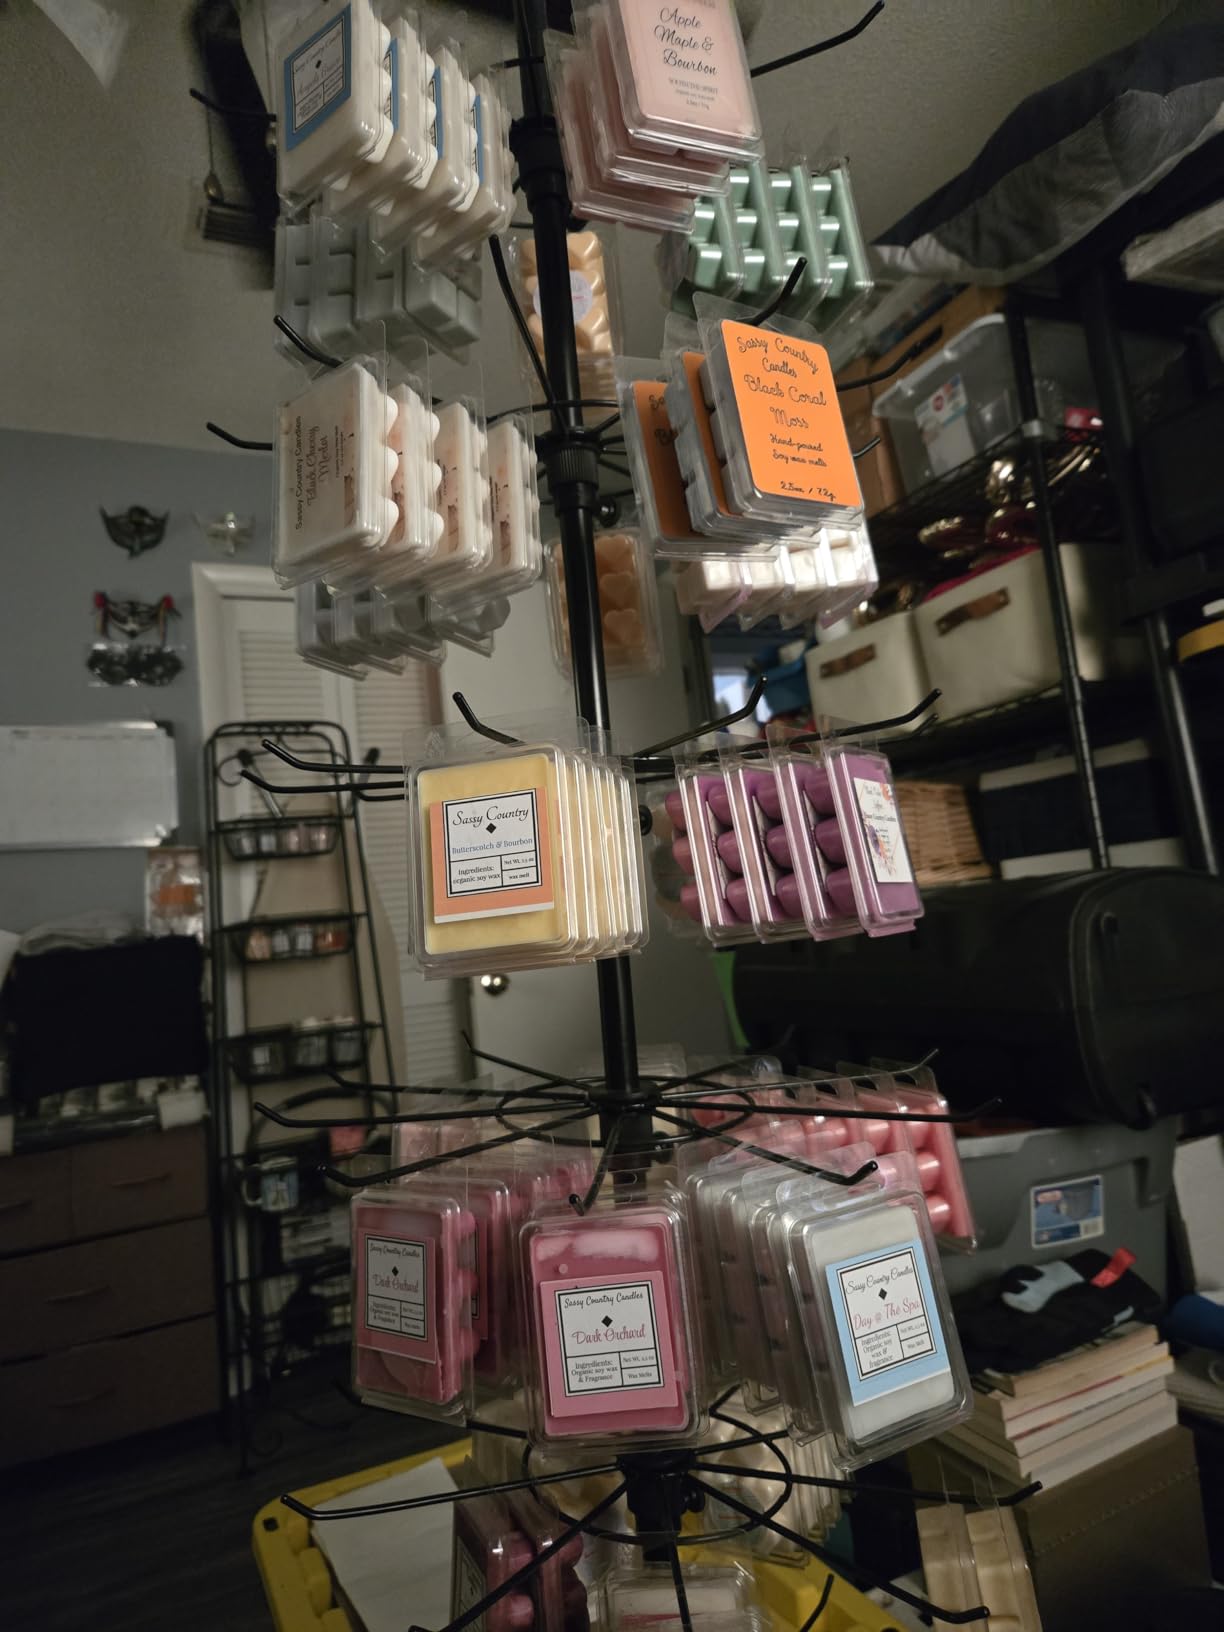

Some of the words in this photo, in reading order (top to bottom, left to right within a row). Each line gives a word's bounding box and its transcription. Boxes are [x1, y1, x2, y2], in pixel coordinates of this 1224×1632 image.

[660, 7, 701, 28] Apple
[654, 24, 699, 49] Maple
[702, 36, 714, 53] &
[663, 48, 717, 76] Bourbon
[737, 336, 768, 354] Sassy
[775, 337, 818, 375] Country
[761, 356, 797, 378] Candles
[743, 373, 785, 398] Black
[788, 385, 827, 406] Coral
[769, 406, 809, 429] Moss
[295, 458, 303, 498] Country
[295, 499, 304, 530] Sassy
[452, 810, 483, 828] Sassy
[486, 805, 529, 822] Country
[452, 841, 495, 855] Butterscotch
[496, 841, 502, 849] &
[503, 838, 533, 848] Bourbon
[453, 876, 475, 885] organic
[476, 874, 487, 882] soy
[458, 865, 495, 876] Ingredients:
[846, 1280, 866, 1295] Sassy
[866, 1274, 890, 1289] Country
[890, 1266, 914, 1280] Candles
[564, 1297, 584, 1309] Sassy
[586, 1295, 614, 1306] Country
[616, 1291, 643, 1303] Candles
[853, 1313, 872, 1330] Day
[884, 1303, 901, 1319] The
[902, 1298, 920, 1315] Spa
[572, 1328, 602, 1345] Dark
[604, 1323, 646, 1342] Orchard
[571, 1368, 594, 1378] Organic
[575, 1359, 613, 1370] Ingredients:
[585, 1374, 613, 1384] Fragrance
